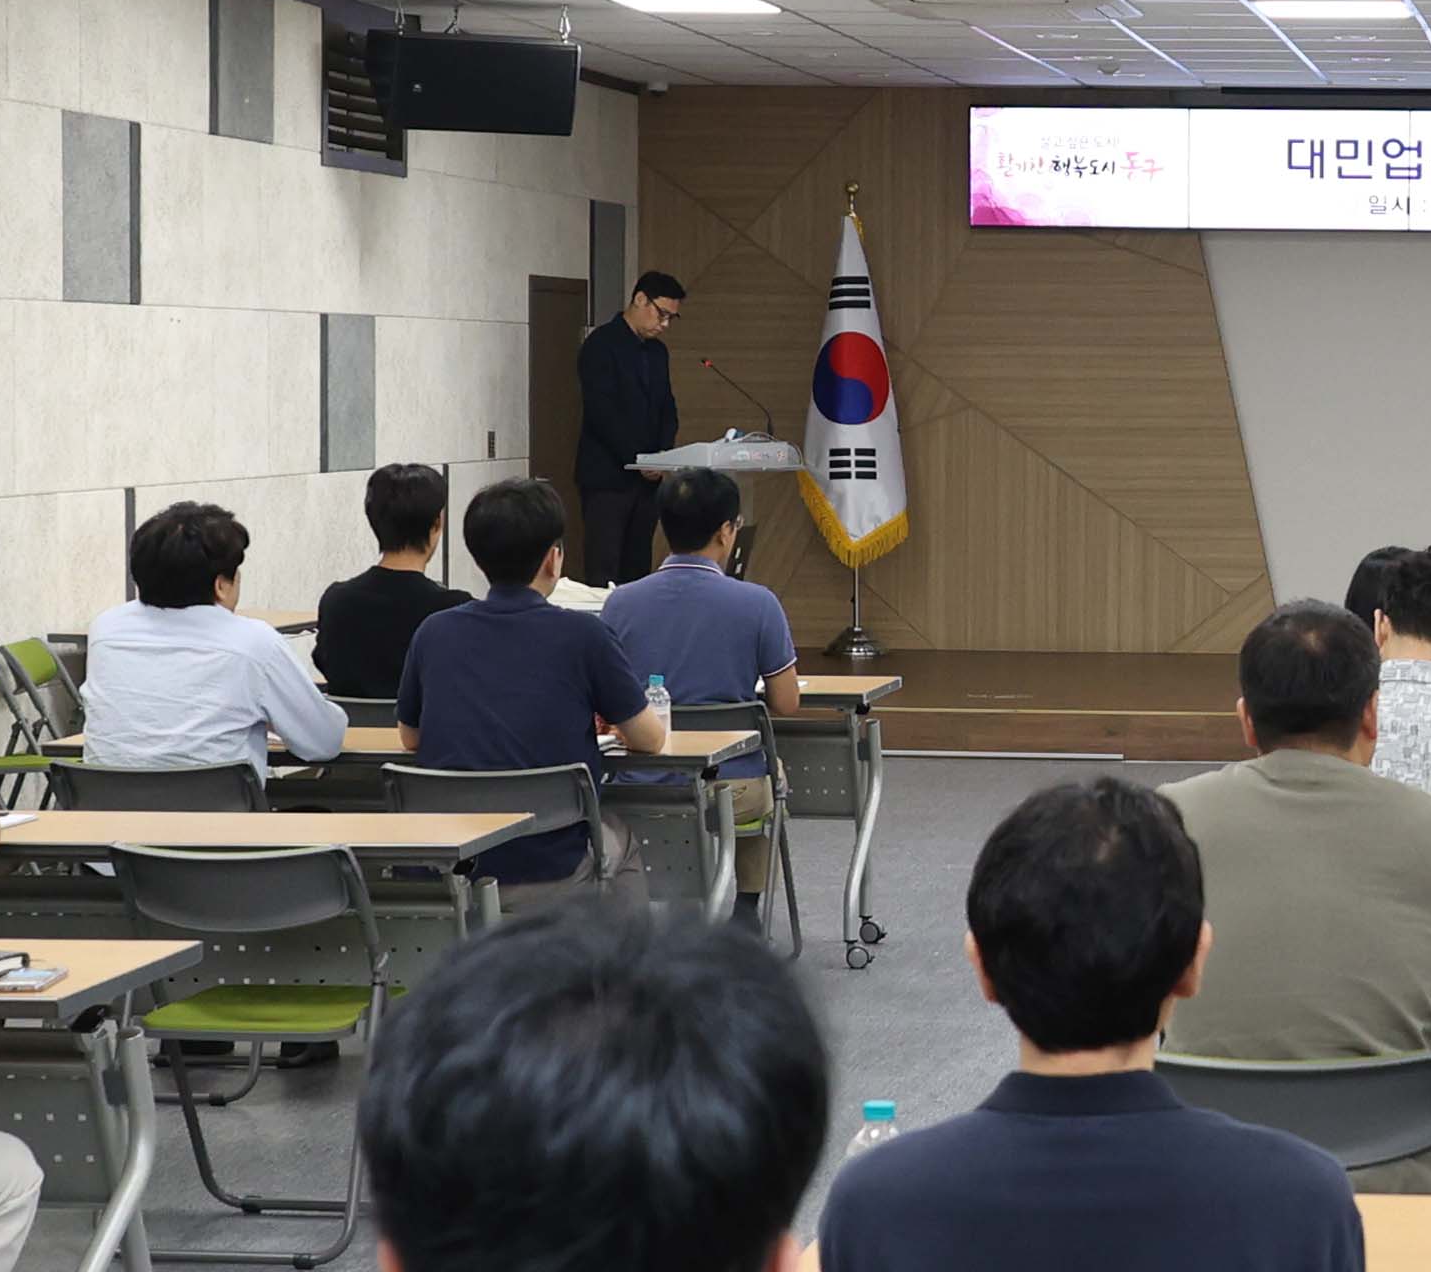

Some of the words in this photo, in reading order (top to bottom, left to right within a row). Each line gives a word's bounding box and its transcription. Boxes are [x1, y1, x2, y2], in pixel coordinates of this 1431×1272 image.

[1051, 155, 1116, 179] 행복도시
[1120, 151, 1164, 182] 동구
[1369, 195, 1411, 216] 일시
